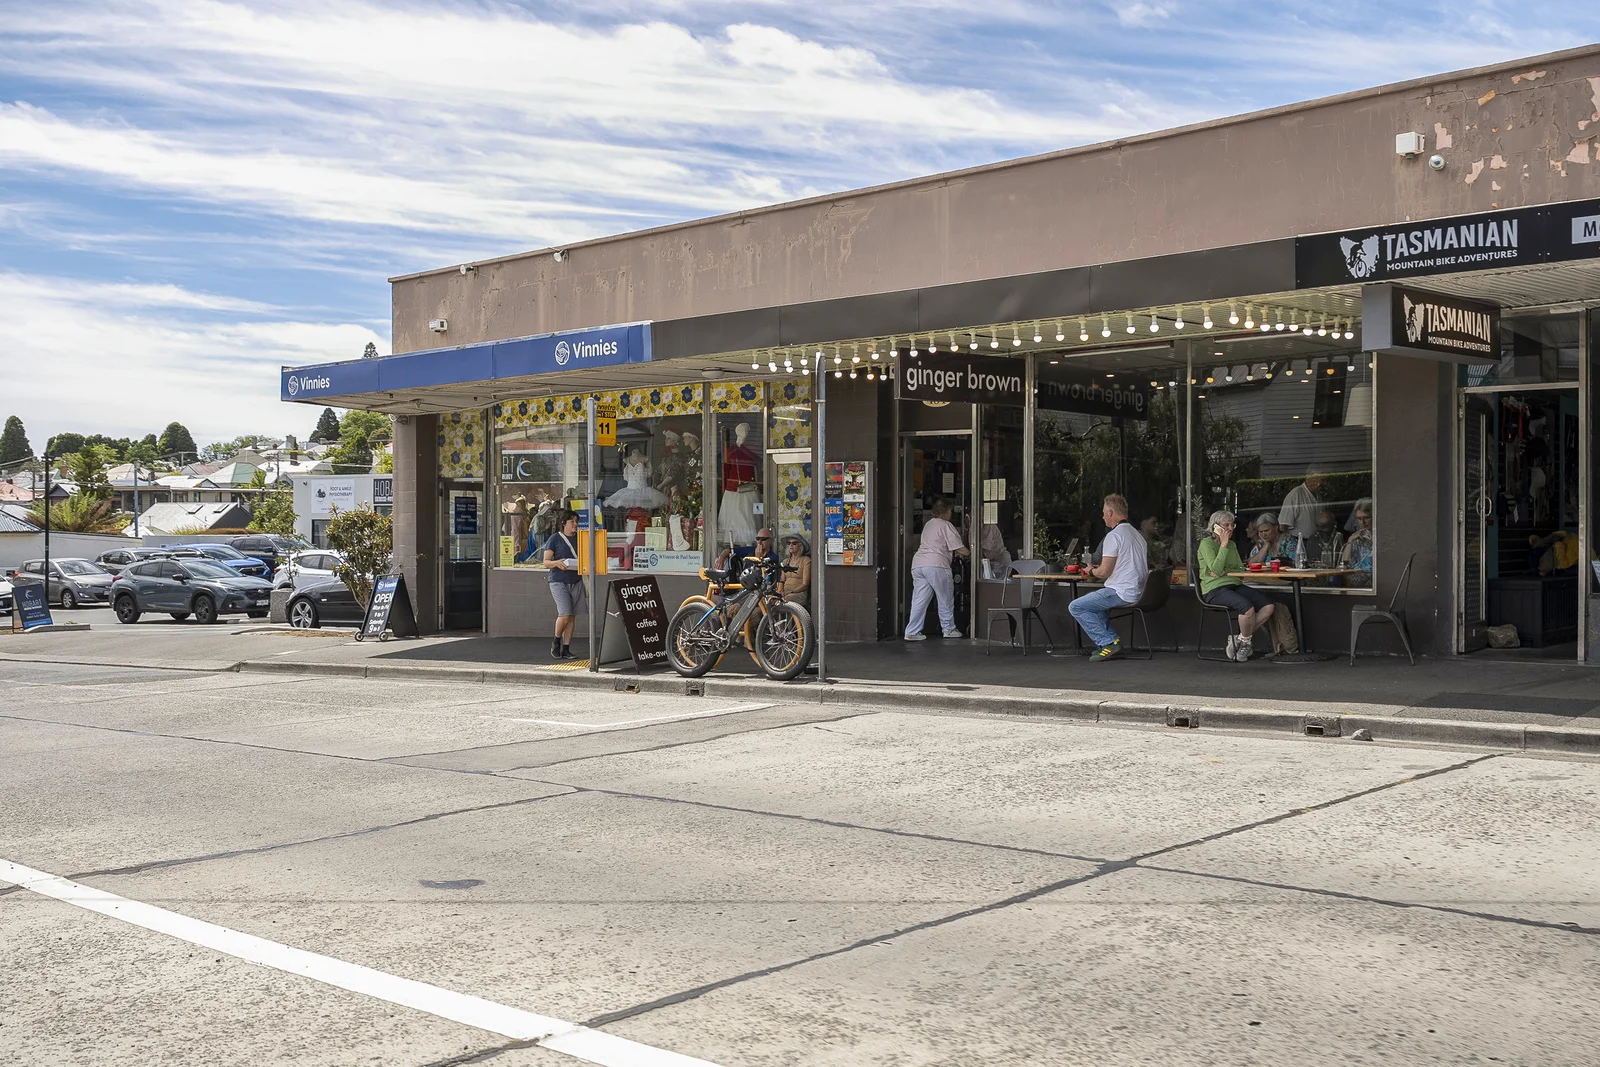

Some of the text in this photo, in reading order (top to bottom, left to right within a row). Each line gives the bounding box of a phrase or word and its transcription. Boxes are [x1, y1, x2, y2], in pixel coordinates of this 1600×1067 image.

[1583, 220, 1600, 238] M
[1382, 218, 1518, 261] TASMANIAN
[1386, 249, 1518, 271] MOUNTAIN BIKE ADVENTURES
[1425, 303, 1491, 343] TASMANIAN
[572, 339, 618, 359] Vinnies
[1428, 335, 1491, 352] MOUNTAIN BIKE ADVENTURES
[300, 375, 330, 391] Vinnies
[906, 360, 1020, 393] ginger brown
[599, 422, 610, 435] 11
[374, 592, 395, 604] OPEN
[620, 583, 652, 599] ginger
[624, 599, 657, 611] brown
[636, 618, 657, 629] coffee
[642, 633, 660, 643] food
[638, 650, 668, 660] take-aw
